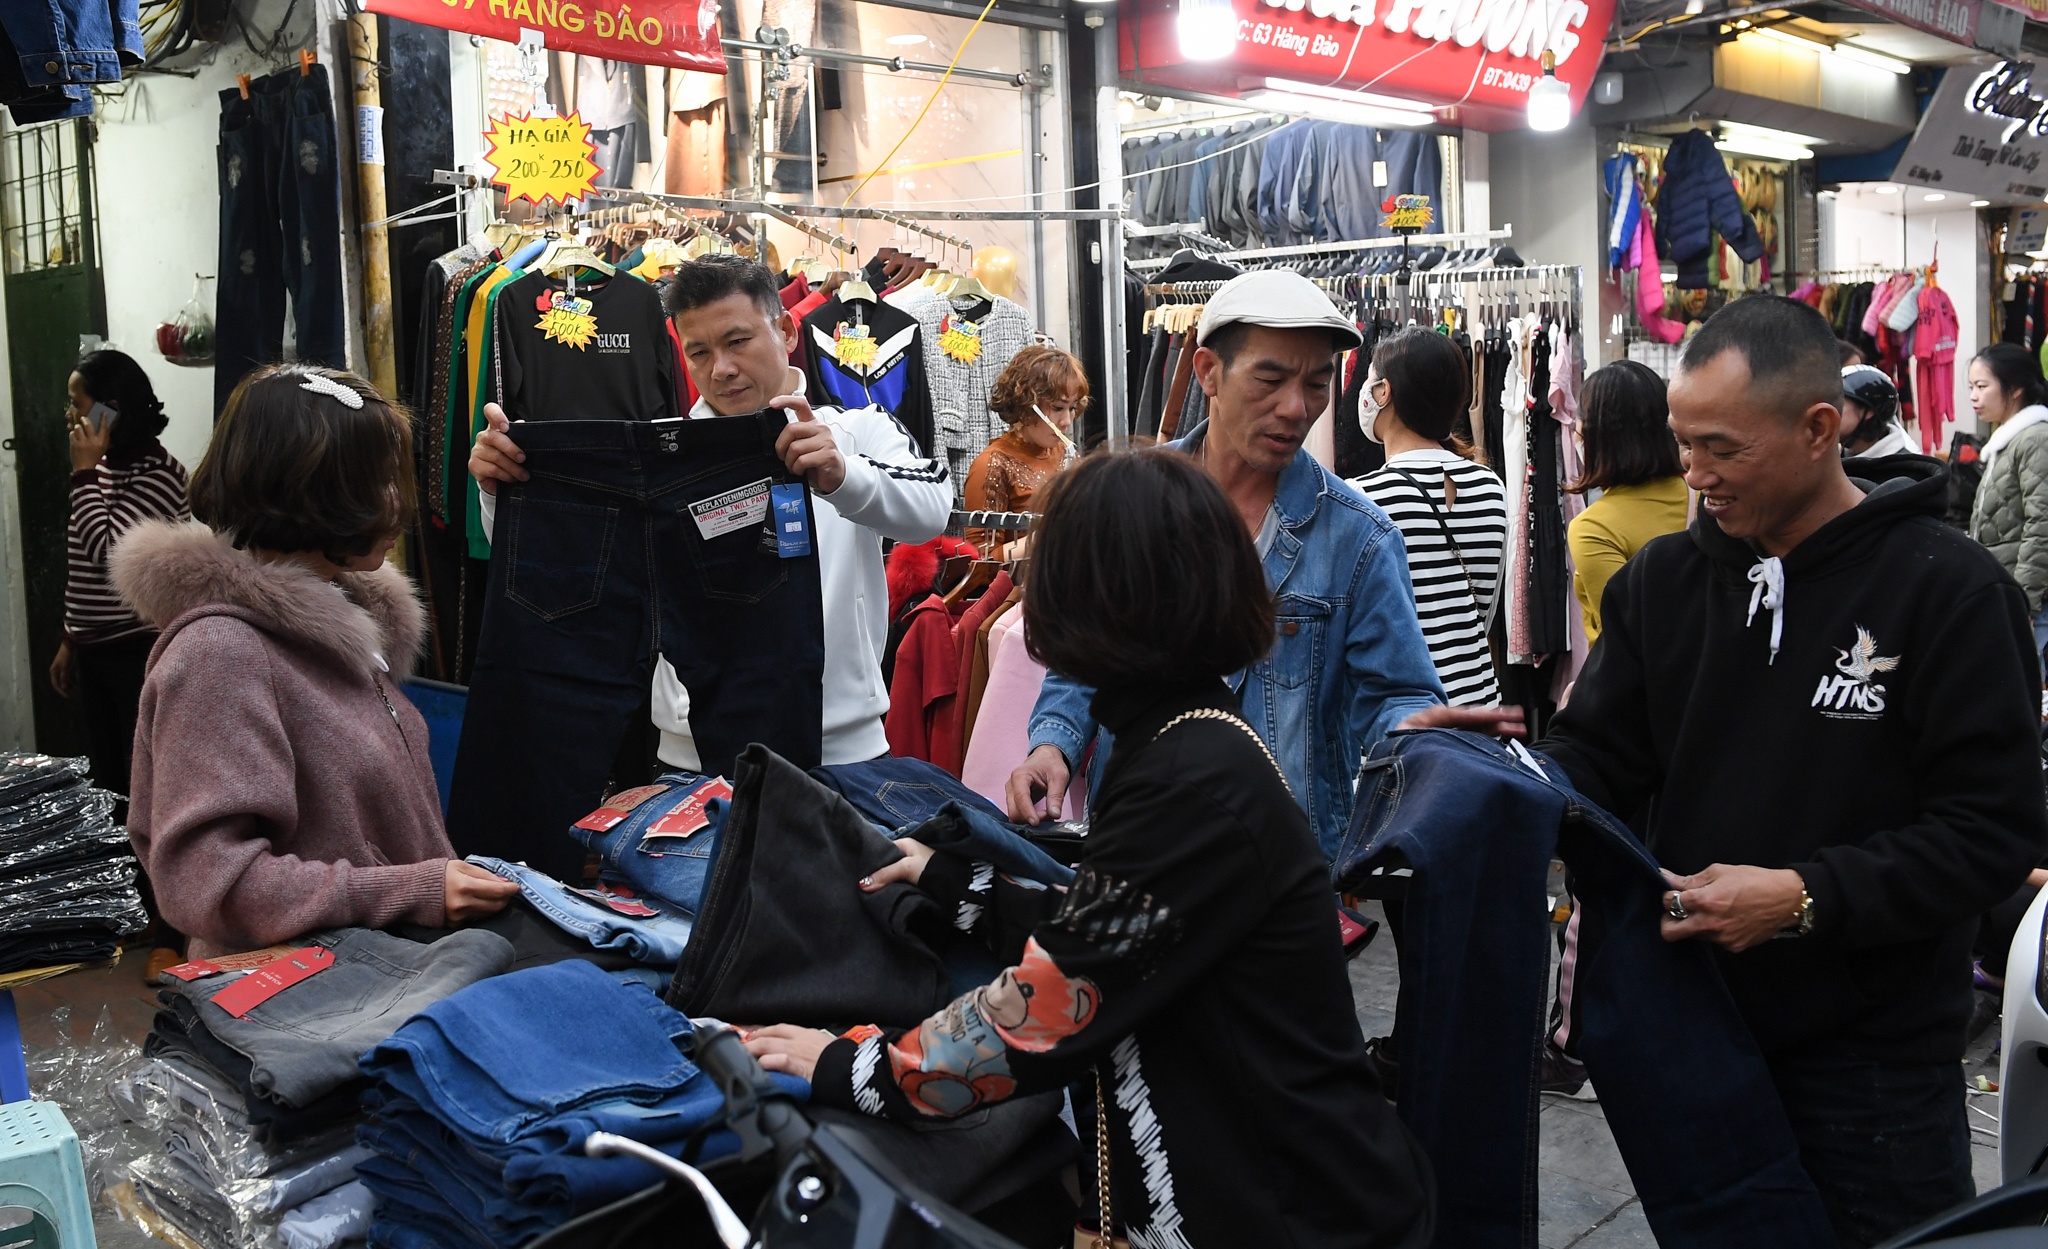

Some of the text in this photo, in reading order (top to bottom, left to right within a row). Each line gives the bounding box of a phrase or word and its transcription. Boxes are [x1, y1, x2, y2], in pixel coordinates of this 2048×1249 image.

[1253, 22, 1272, 45] 63
[508, 122, 574, 148] HẠ GIÁ
[597, 333, 630, 348] GUCCI
[696, 482, 768, 514] REPLAYDENIMGOODS
[698, 505, 729, 523] ORIGINAL
[729, 498, 750, 512] TWILL
[1811, 674, 1887, 713] HTNS
[684, 802, 704, 815] 514
